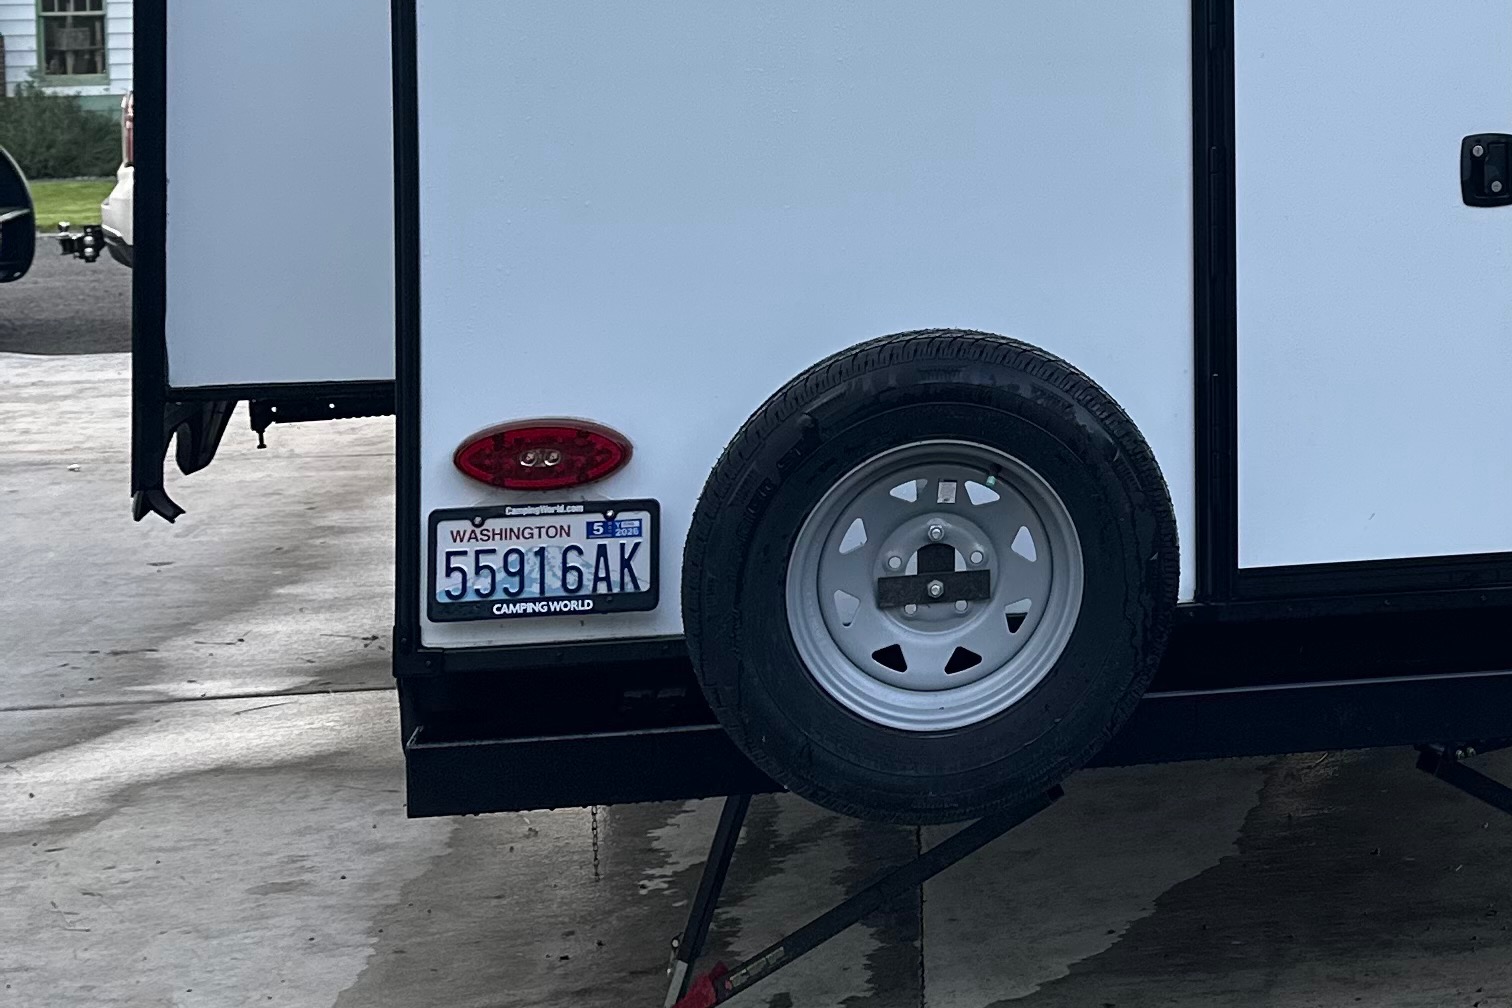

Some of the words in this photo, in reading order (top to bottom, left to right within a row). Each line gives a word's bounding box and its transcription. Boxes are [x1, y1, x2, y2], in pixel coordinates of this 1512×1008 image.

[505, 503, 584, 516] CampingWorld.com
[450, 524, 571, 543] WASHINGTON
[592, 522, 604, 535] 5
[444, 541, 642, 601] 55916AK
[493, 601, 549, 615] CAMPING
[549, 599, 593, 612] WORLD
